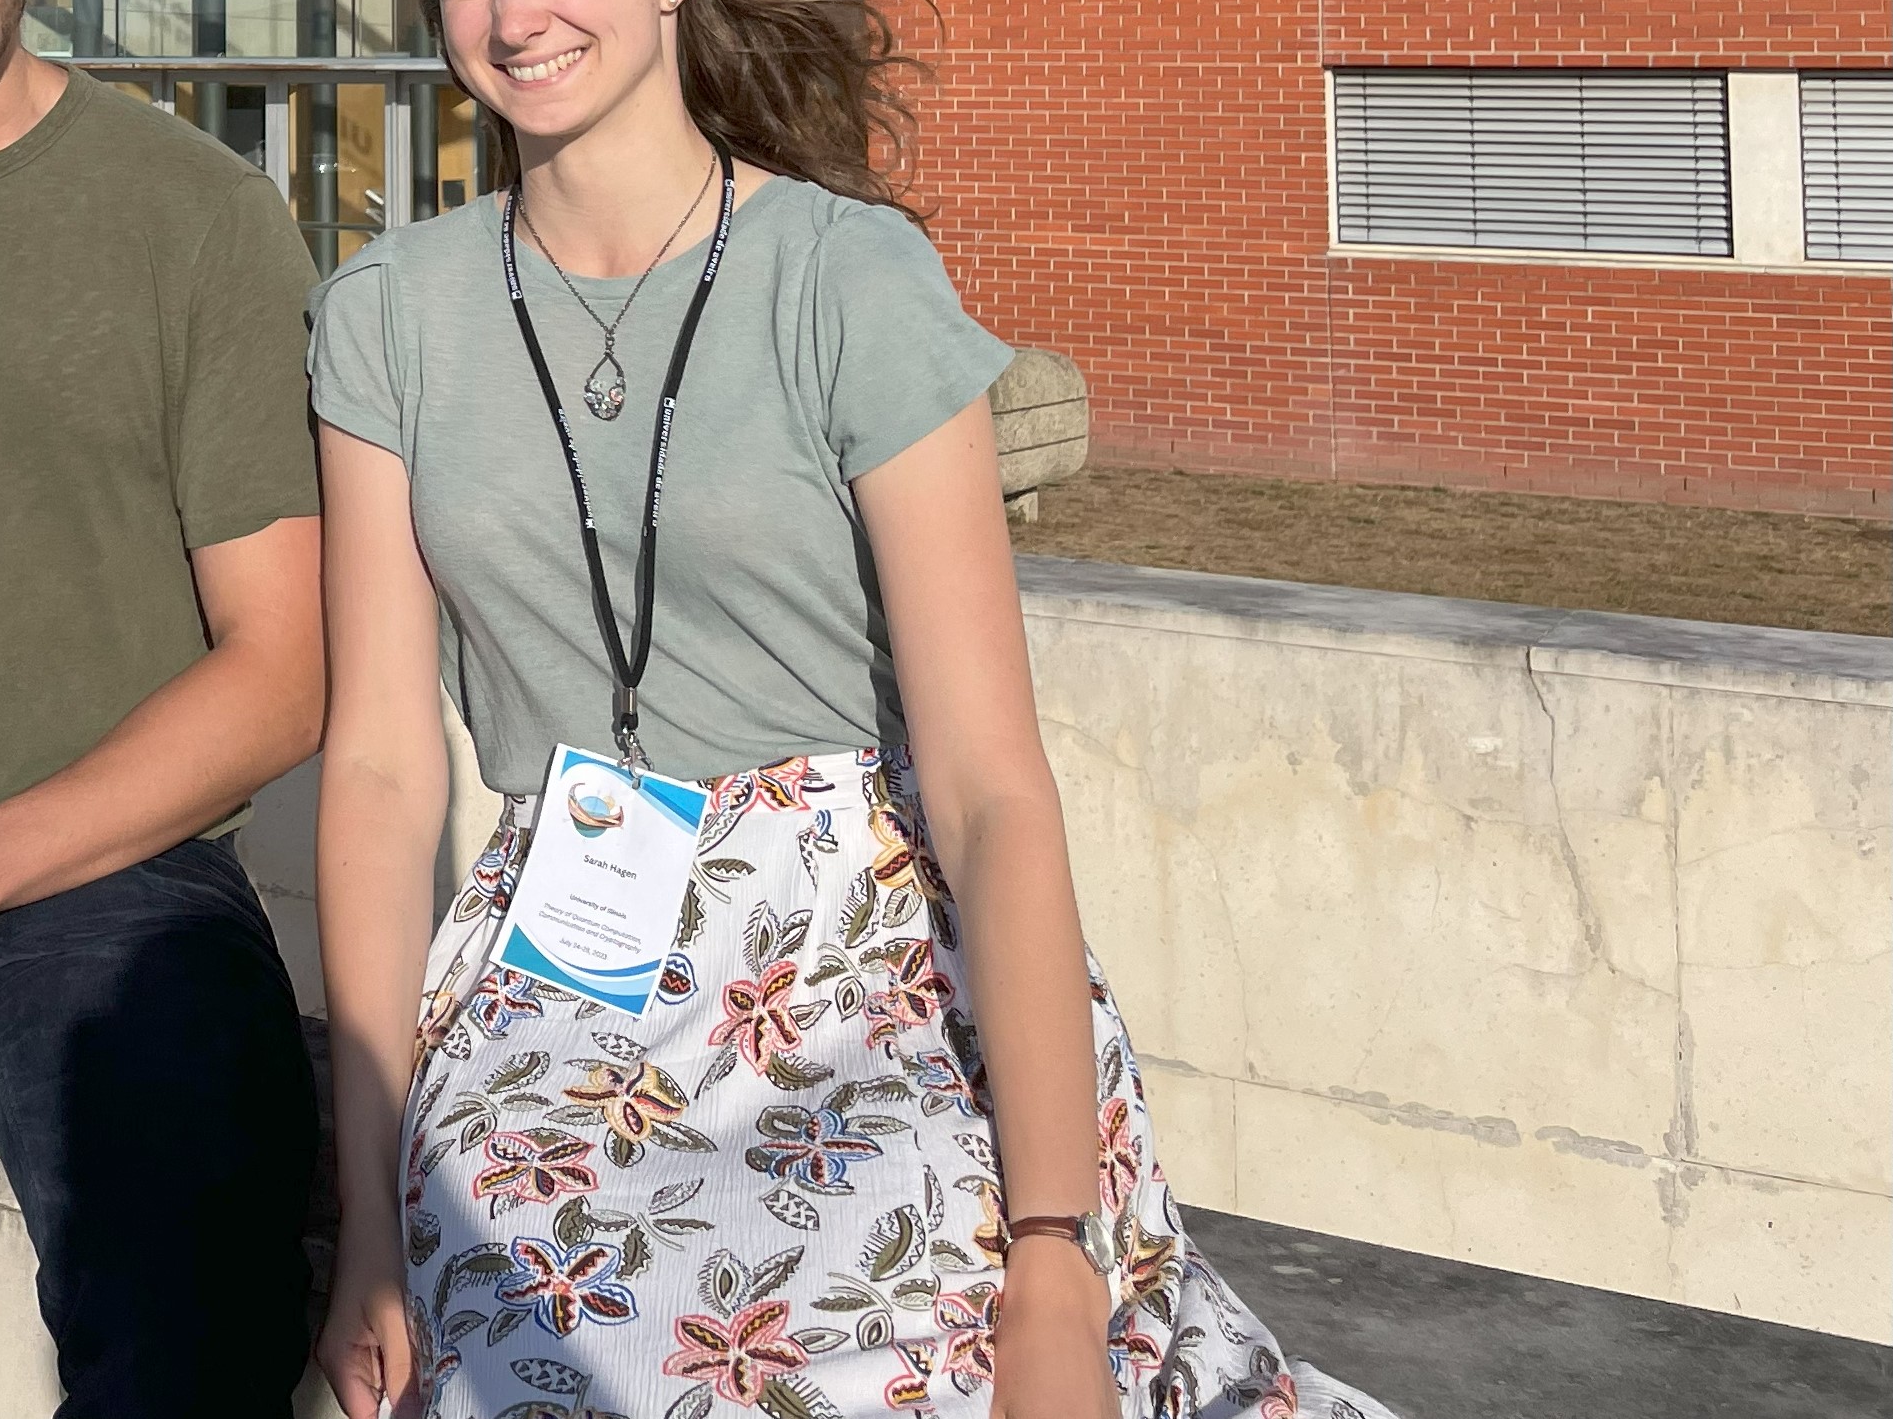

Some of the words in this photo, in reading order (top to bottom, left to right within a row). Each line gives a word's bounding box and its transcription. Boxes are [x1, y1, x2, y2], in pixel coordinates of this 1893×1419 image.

[714, 240, 726, 252] de
[704, 252, 720, 282] aveiro
[583, 854, 609, 870] Sarah
[609, 863, 637, 880] Hagen
